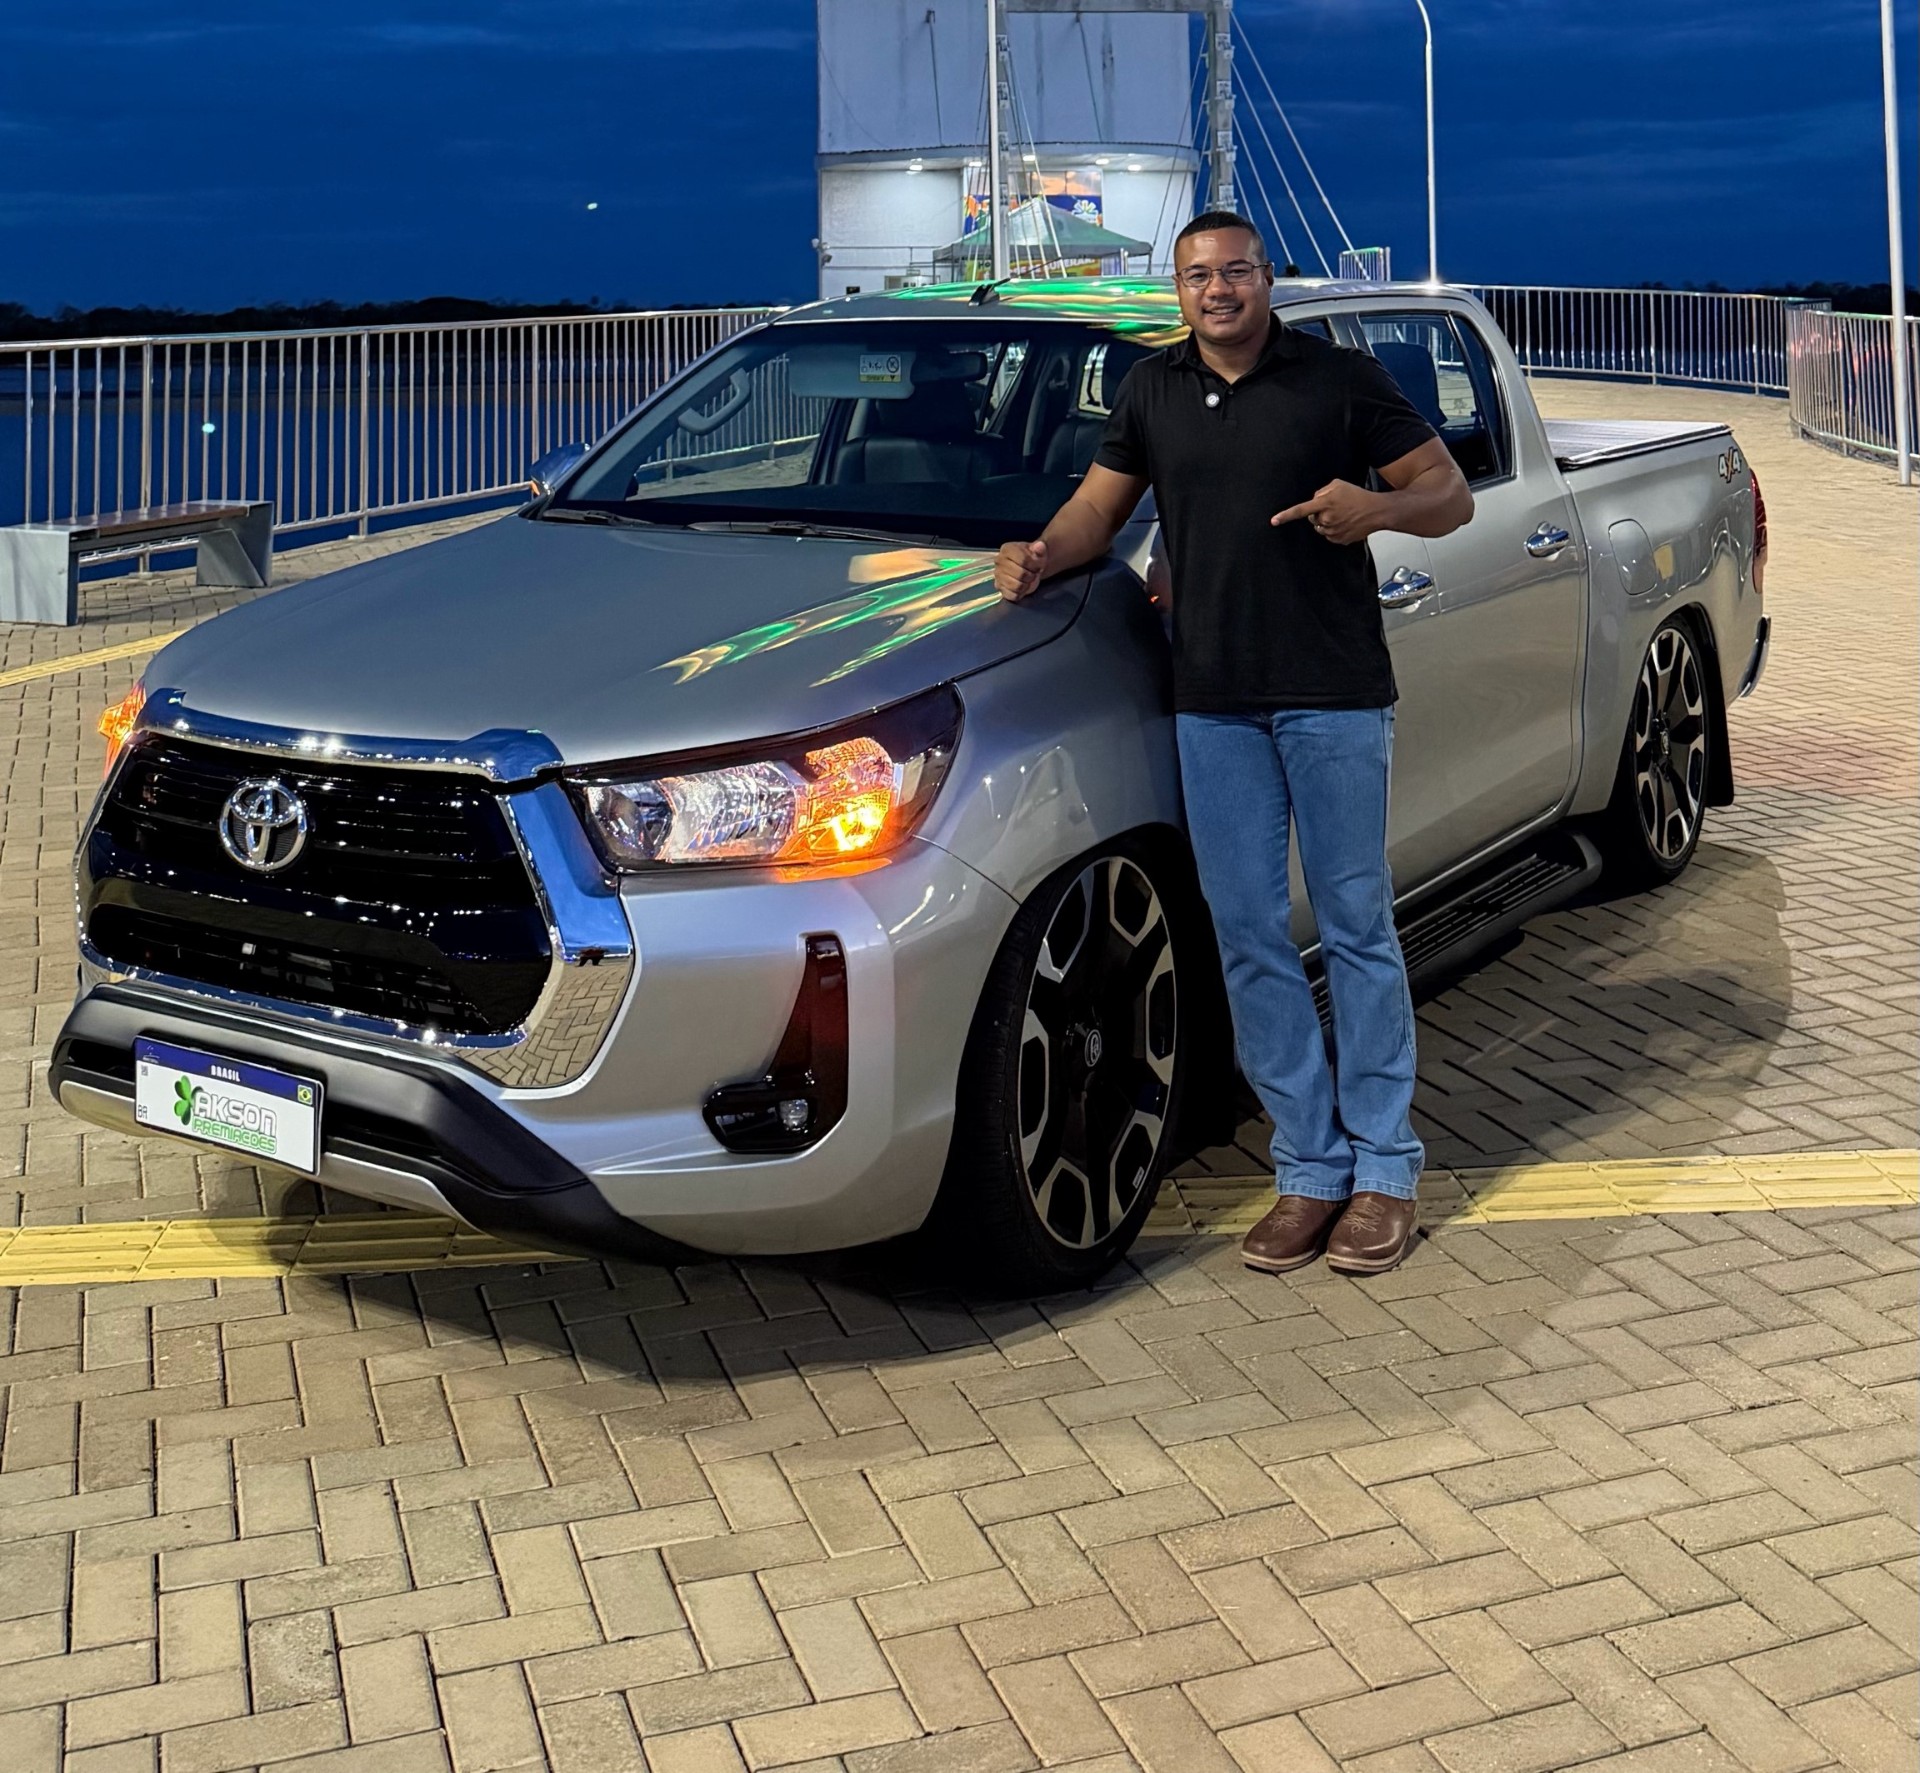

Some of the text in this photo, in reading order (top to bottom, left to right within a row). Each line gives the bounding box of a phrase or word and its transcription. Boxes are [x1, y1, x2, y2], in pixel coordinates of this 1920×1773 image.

[210, 1065, 241, 1083] BRASIL
[138, 1104, 148, 1120] BR
[193, 1091, 277, 1137] AKSON
